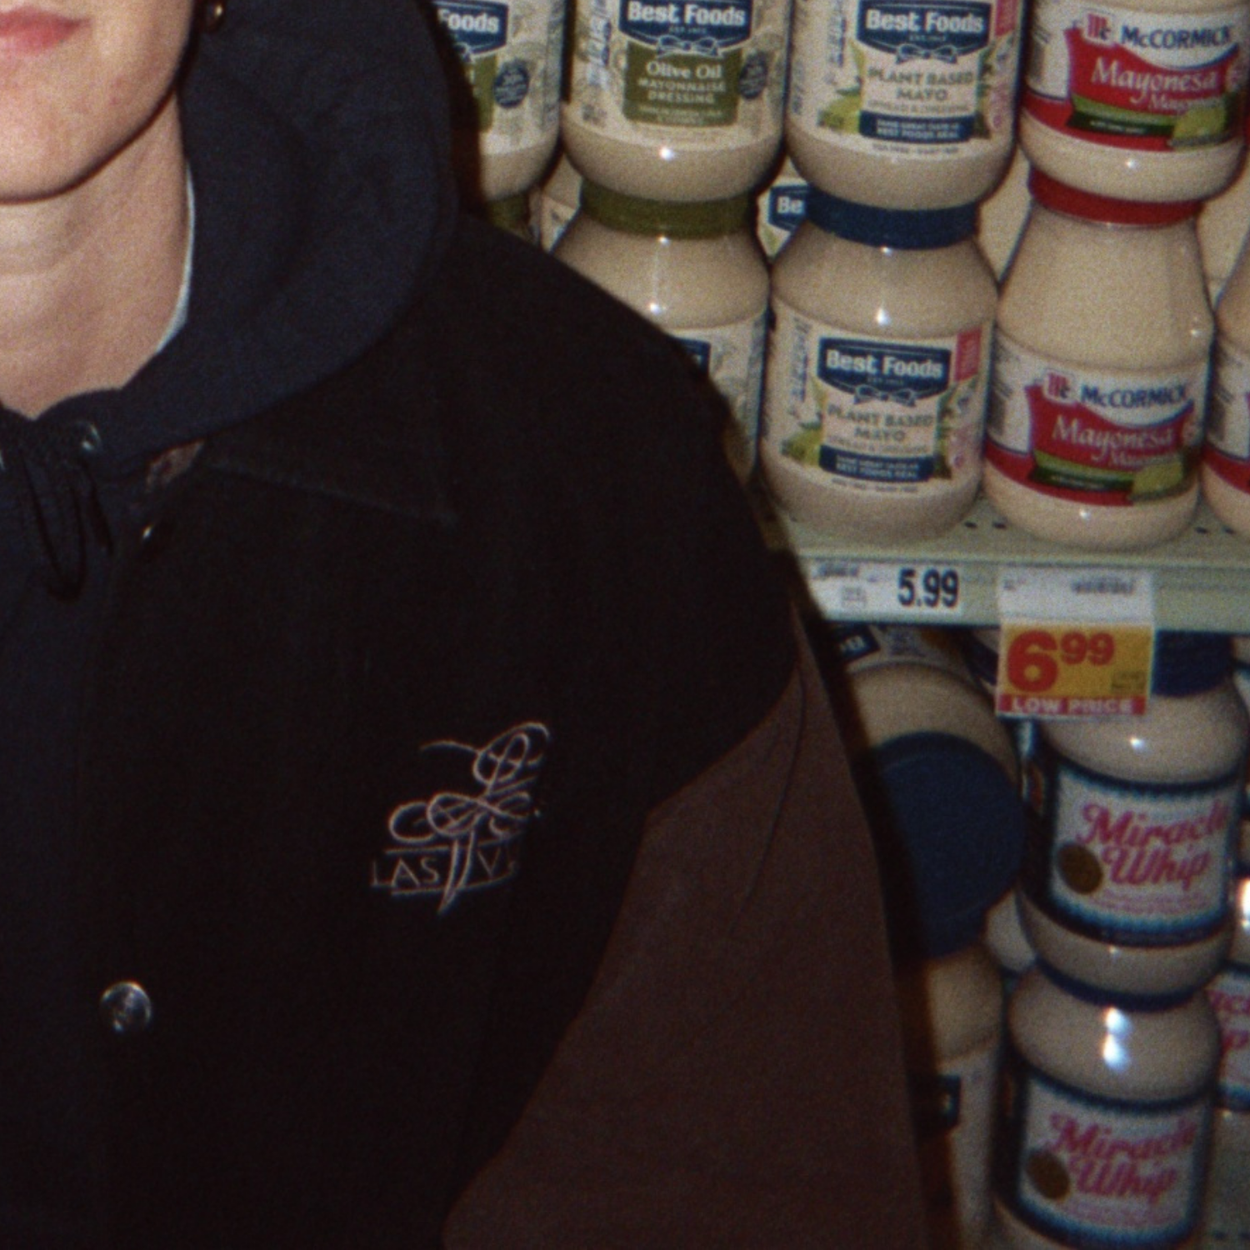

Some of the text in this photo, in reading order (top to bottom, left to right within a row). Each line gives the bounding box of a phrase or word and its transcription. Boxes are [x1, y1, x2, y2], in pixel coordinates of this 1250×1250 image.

[438, 9, 500, 34] Foods
[627, 1, 746, 26] Best Foods
[866, 9, 984, 34] Best Foods
[646, 61, 723, 80] Olive Oil
[867, 67, 974, 86] PLANT BASED
[1091, 56, 1219, 105] Mayonesa
[638, 79, 726, 93] MAYONNAISE
[647, 90, 715, 104] DRESSING
[897, 88, 949, 101] MAYO
[826, 350, 944, 379] Best Foods
[854, 427, 907, 442] MAYO
[1053, 414, 1174, 461] Mayonesa
[897, 568, 959, 608] 5.99
[1012, 697, 1134, 715] LOW PRICE
[1101, 843, 1213, 890] Whip
[1068, 1153, 1178, 1204] Whip
